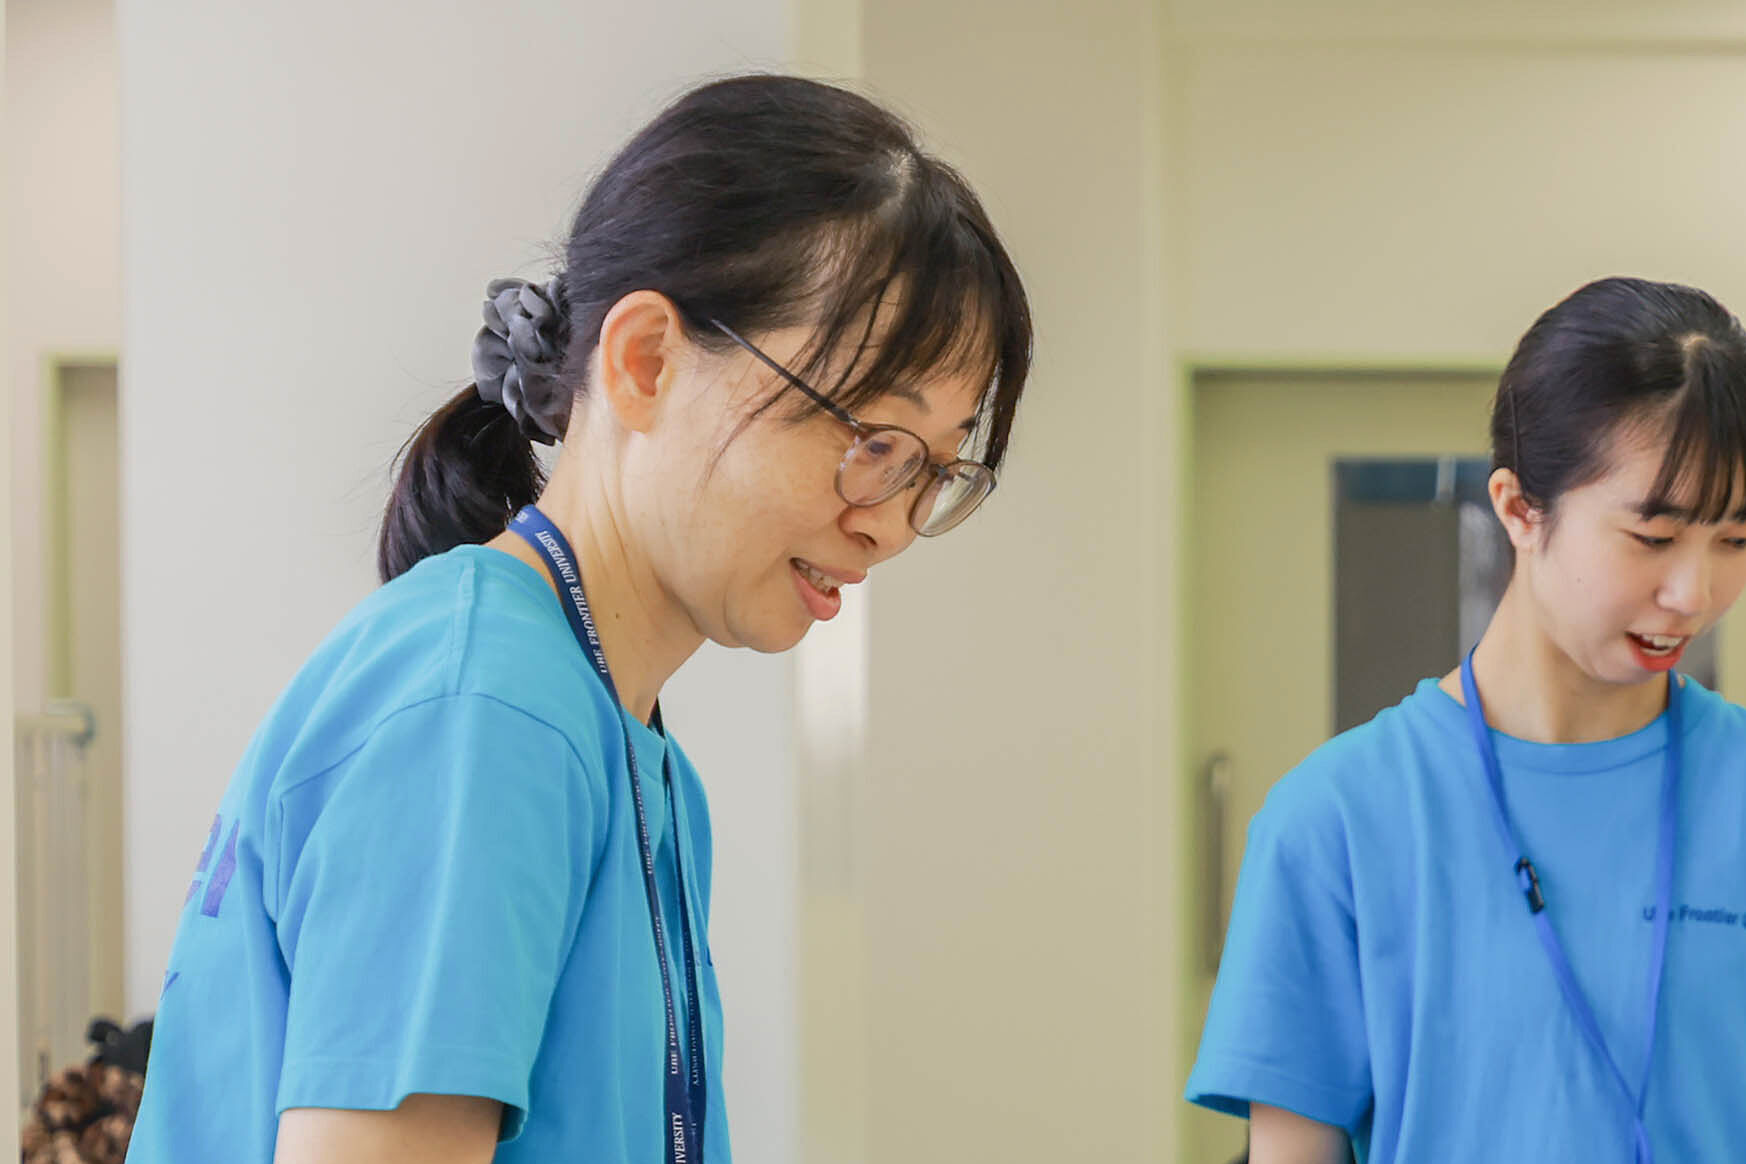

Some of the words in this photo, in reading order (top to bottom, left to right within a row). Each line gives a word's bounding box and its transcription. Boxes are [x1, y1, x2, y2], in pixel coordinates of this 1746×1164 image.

[535, 530, 577, 584] UNIVERSITY
[569, 585, 600, 646] FRONTIER
[1679, 904, 1738, 926] Frontier
